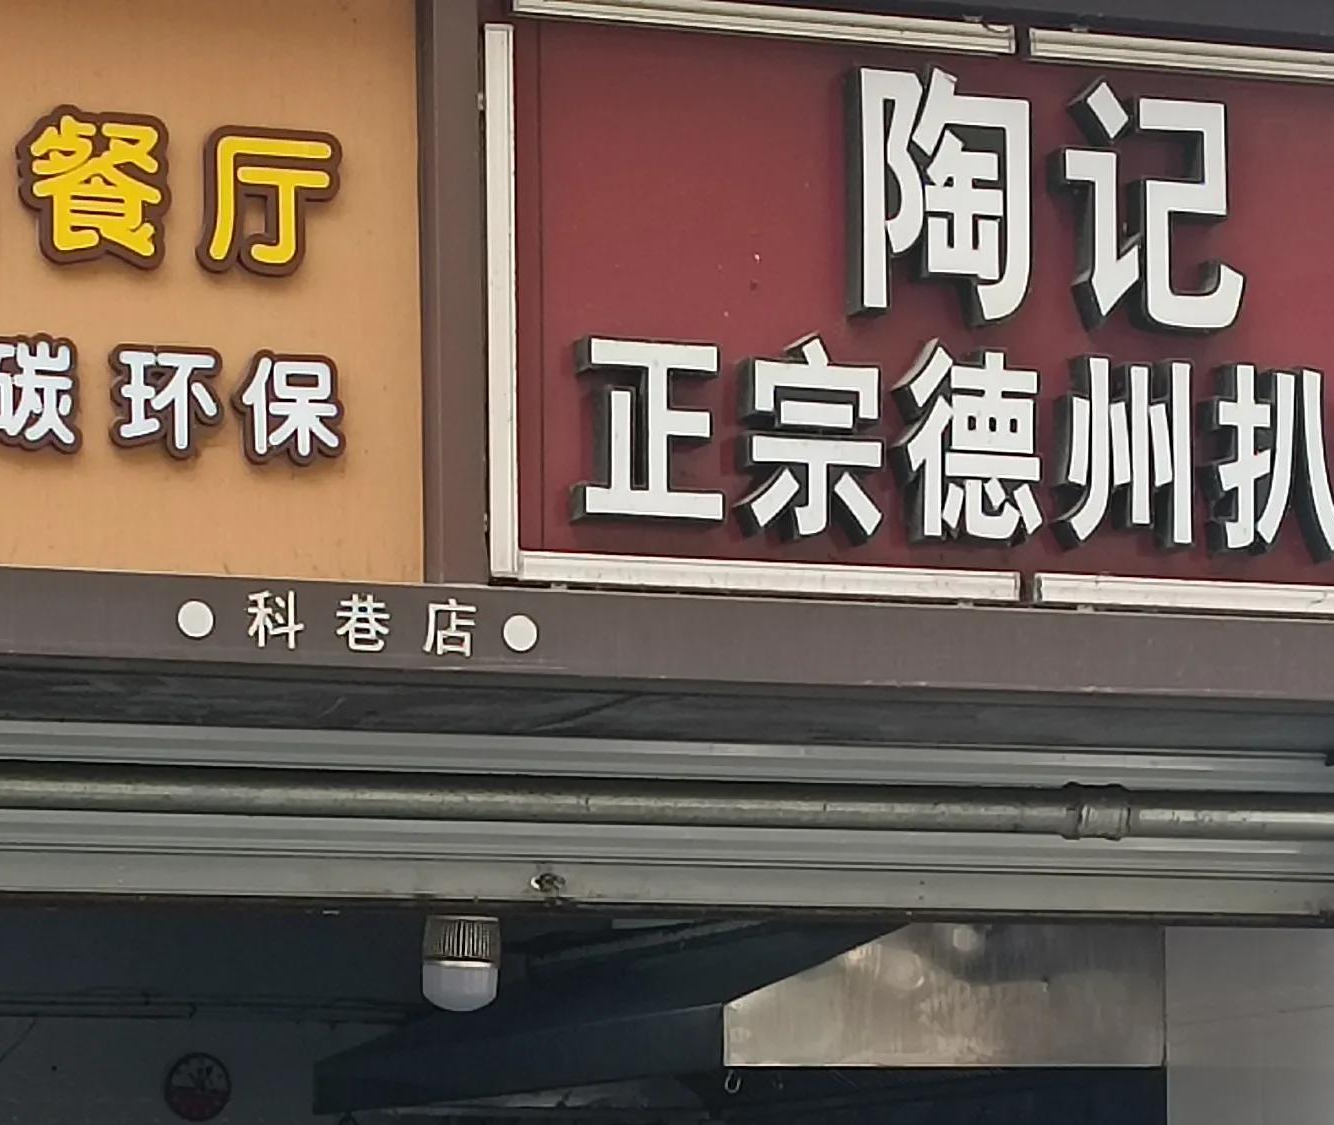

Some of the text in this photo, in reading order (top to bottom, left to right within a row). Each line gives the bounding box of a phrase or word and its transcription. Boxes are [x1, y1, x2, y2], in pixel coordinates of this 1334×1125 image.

[855, 66, 1247, 331] 陶记
[244, 589, 478, 658] 科巷店
